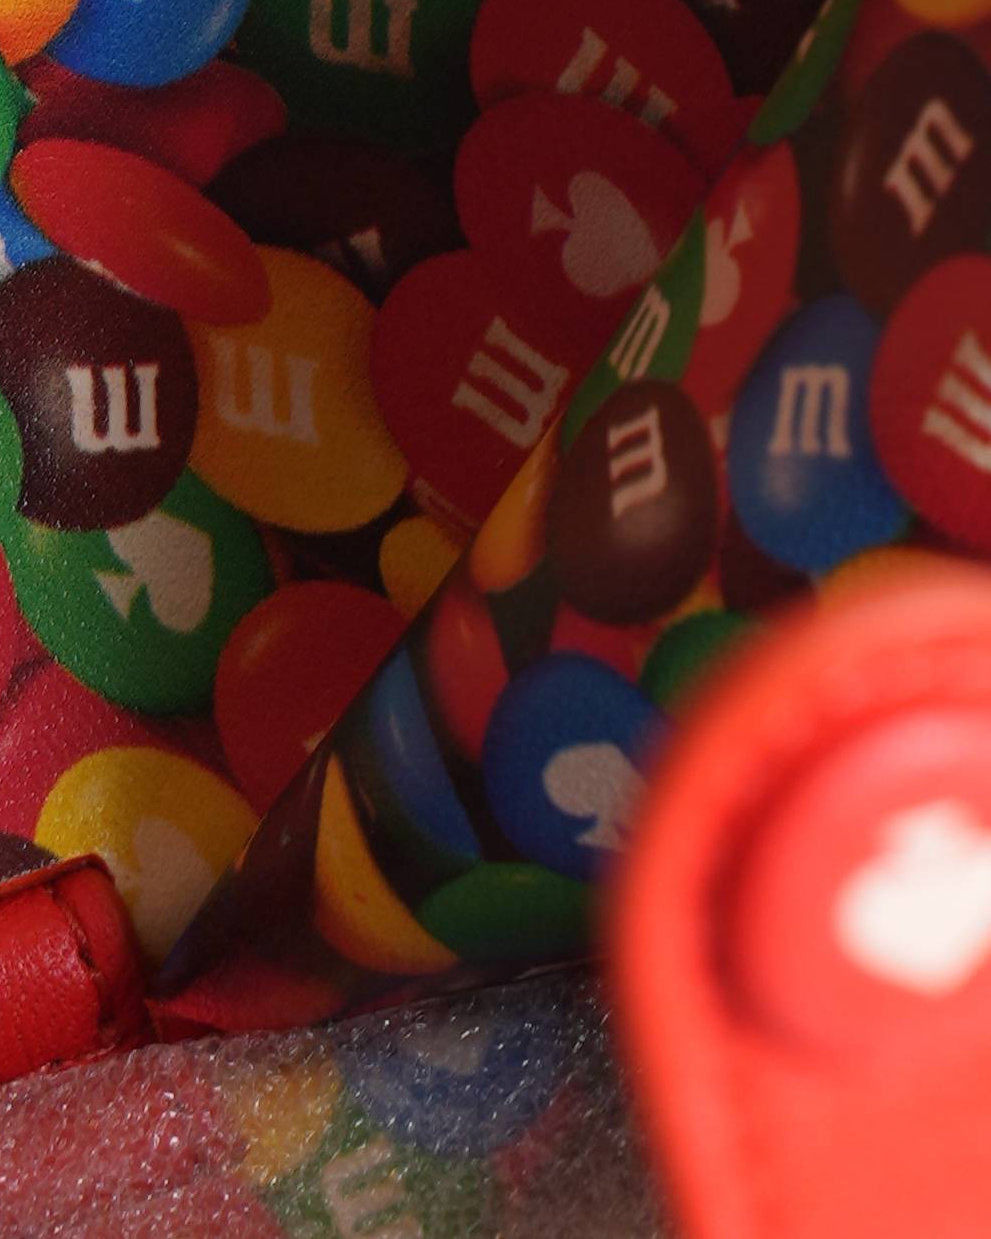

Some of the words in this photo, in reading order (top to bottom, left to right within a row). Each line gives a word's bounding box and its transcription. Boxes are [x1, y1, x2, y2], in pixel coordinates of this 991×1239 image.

[884, 96, 975, 238] m
[65, 362, 161, 455] m
[452, 315, 569, 450] m
[767, 364, 852, 458] m
[609, 404, 668, 520] m
